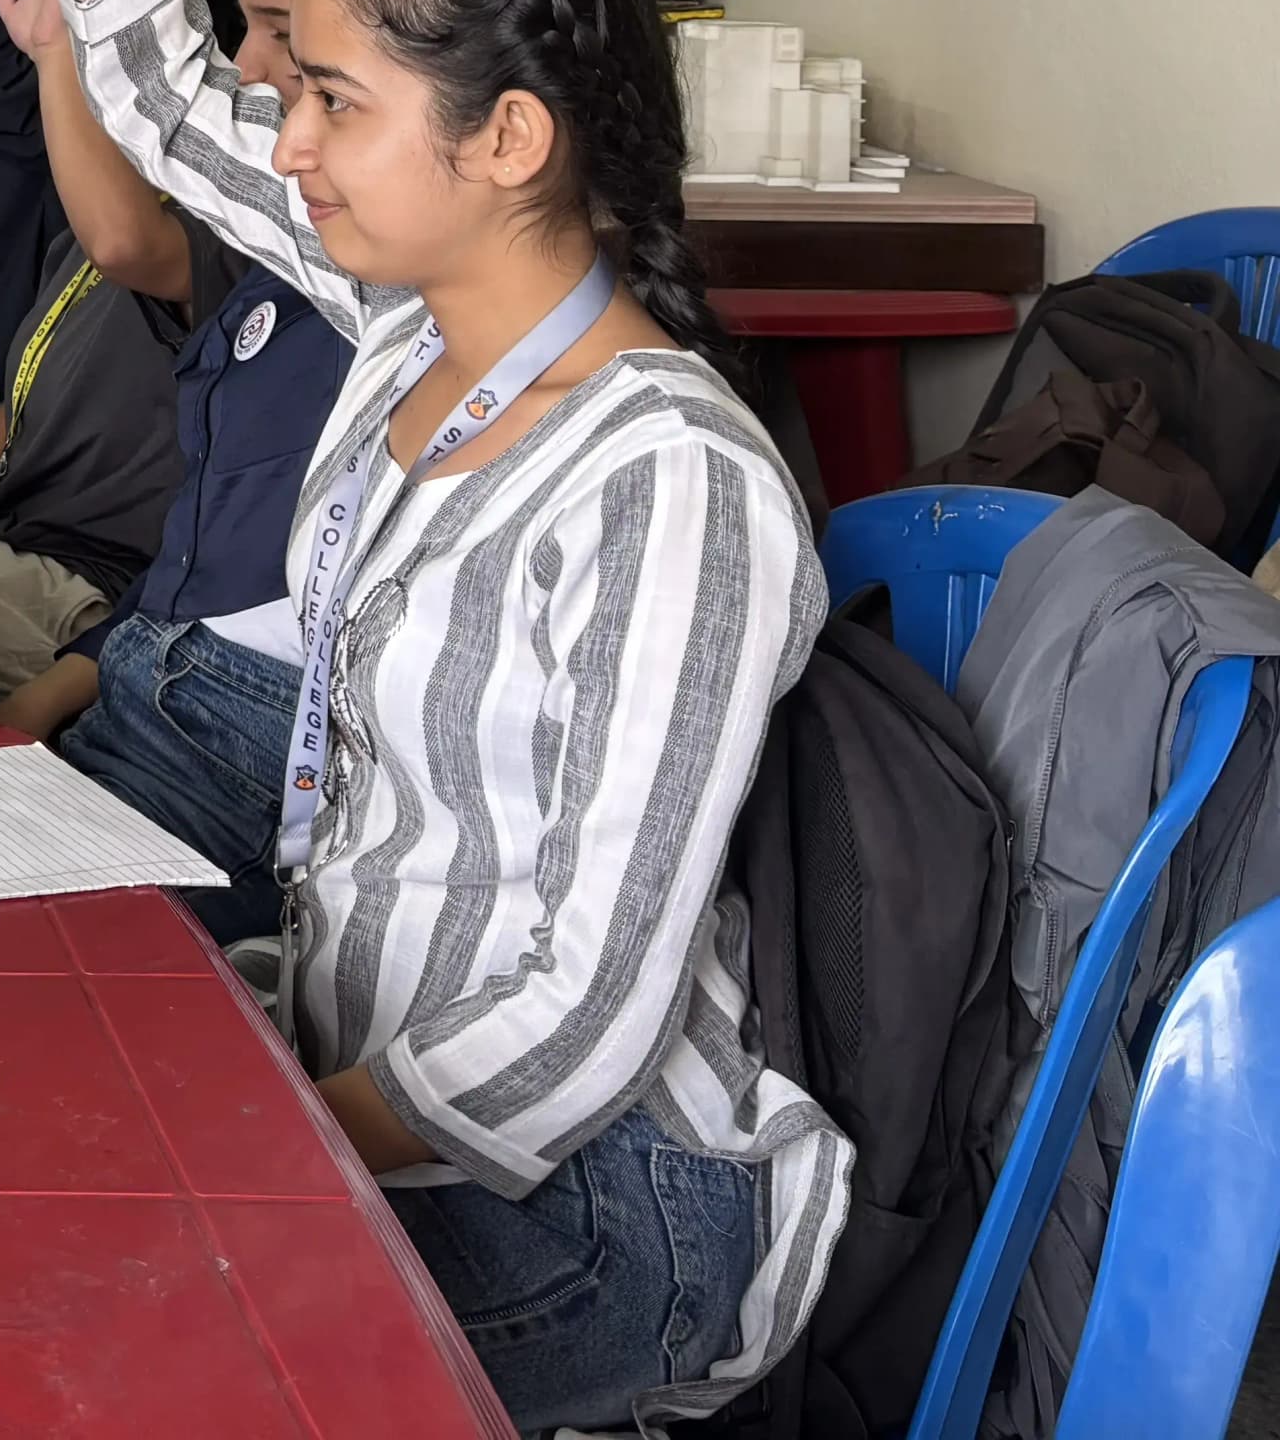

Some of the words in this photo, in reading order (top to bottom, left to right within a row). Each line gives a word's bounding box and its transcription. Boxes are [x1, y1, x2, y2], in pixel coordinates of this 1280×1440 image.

[427, 426, 462, 462] ST.
[305, 503, 346, 657] COLLEG
[303, 598, 341, 752] COLLEGE
